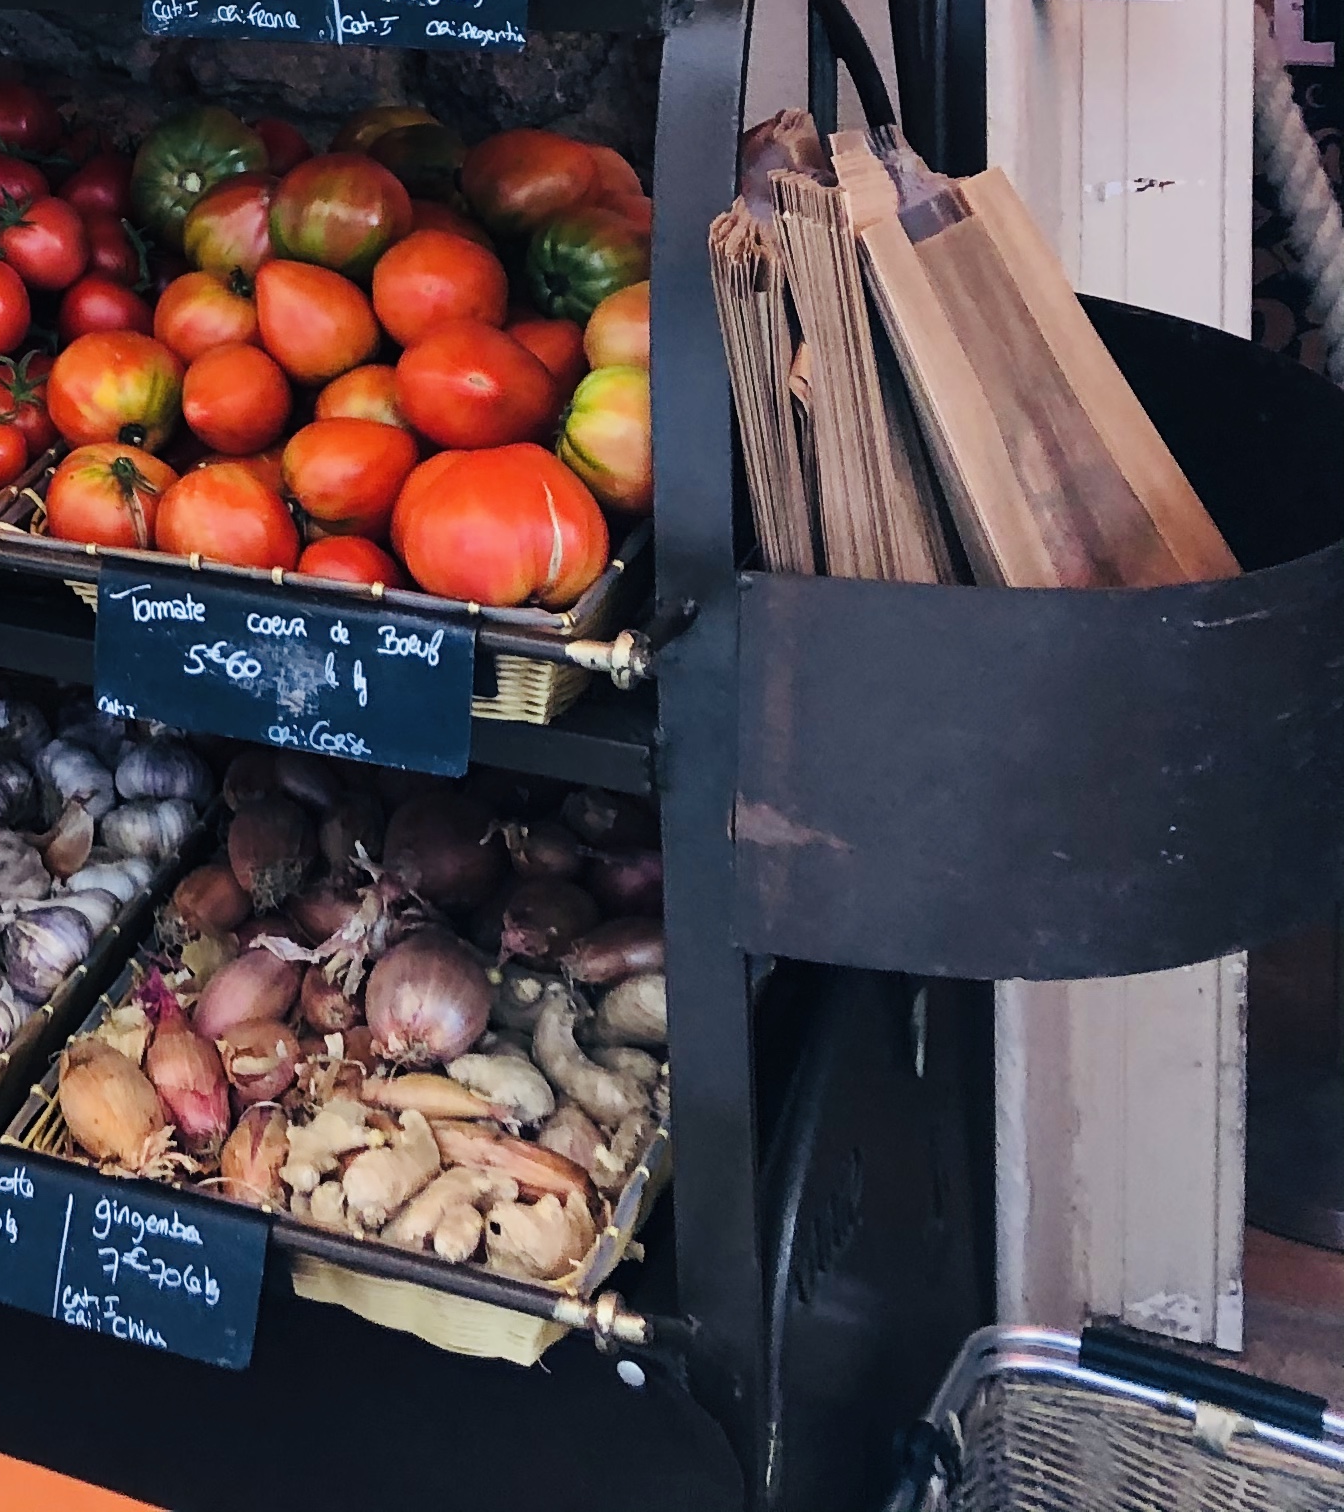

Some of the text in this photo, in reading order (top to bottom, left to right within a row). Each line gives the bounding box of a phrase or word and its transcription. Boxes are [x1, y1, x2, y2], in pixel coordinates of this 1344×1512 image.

[110, 584, 206, 623] Tomate
[330, 619, 350, 645] de
[183, 640, 262, 680] 5€60
[97, 1245, 181, 1291] 7€70
